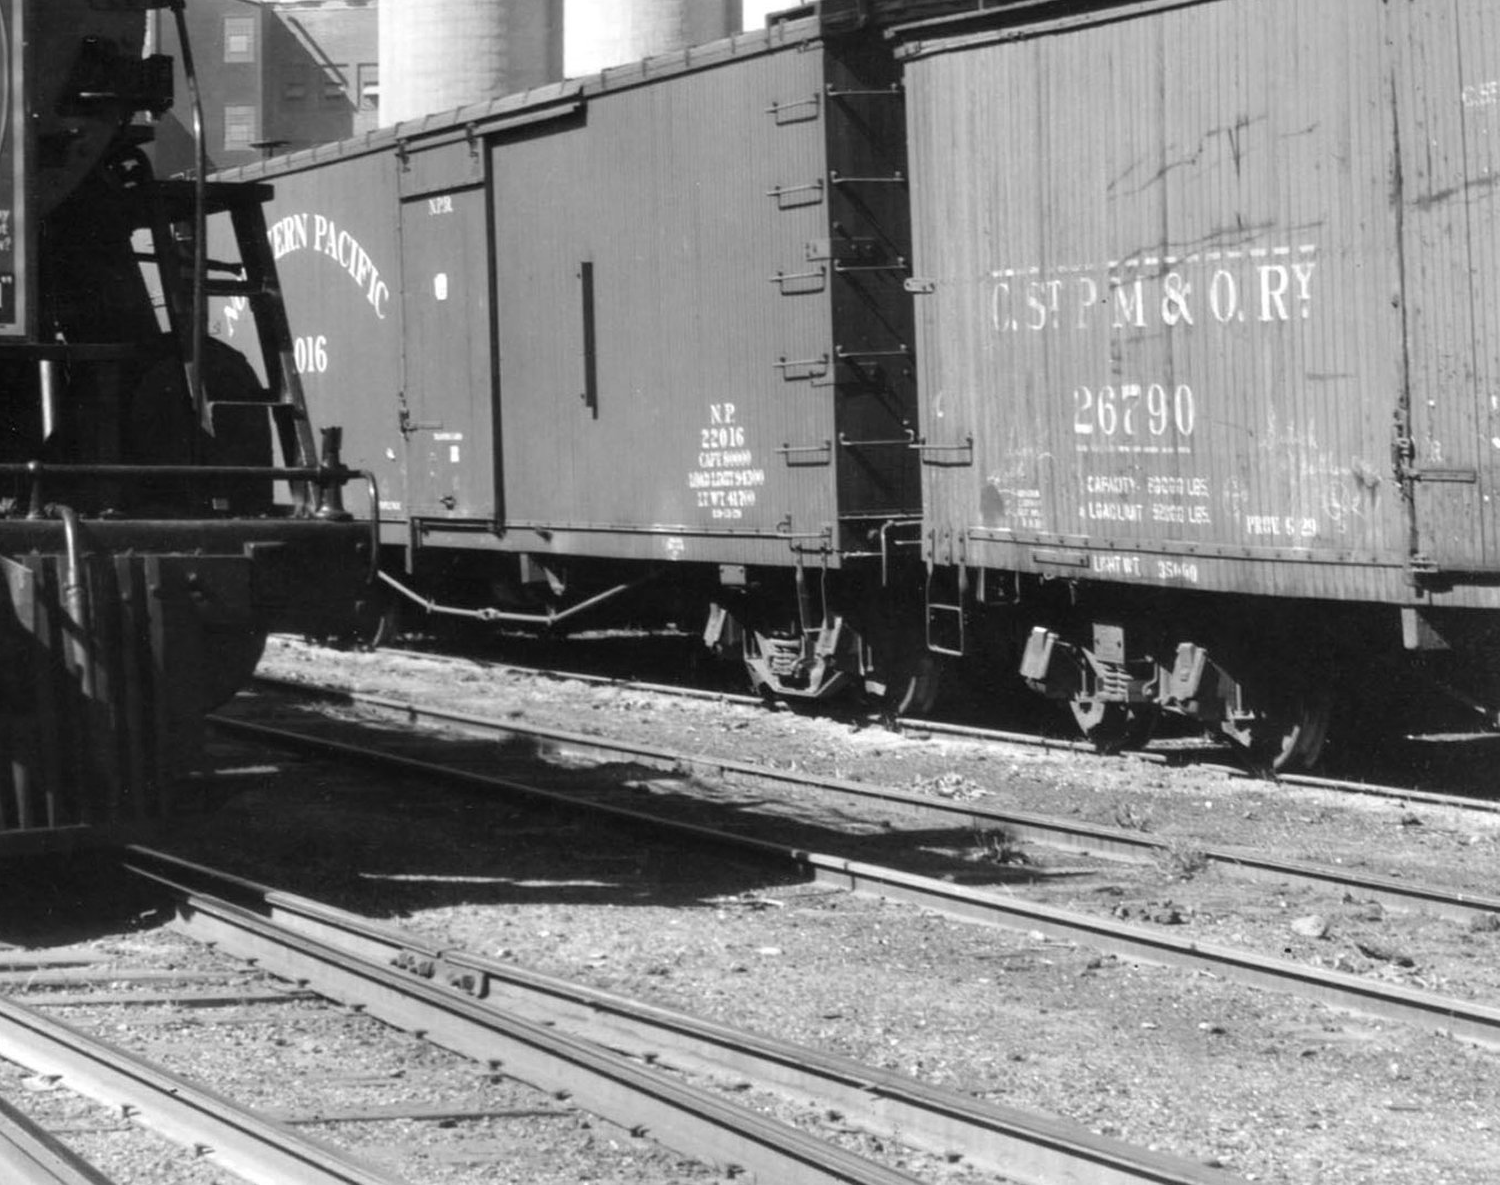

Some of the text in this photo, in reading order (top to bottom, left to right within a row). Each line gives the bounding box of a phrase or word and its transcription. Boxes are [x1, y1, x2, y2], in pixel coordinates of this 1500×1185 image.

[313, 214, 389, 319] PACIFIC
[1161, 272, 1194, 326] &
[293, 334, 328, 373] 016
[1073, 383, 1195, 436] 26790
[701, 426, 745, 449] 22016
